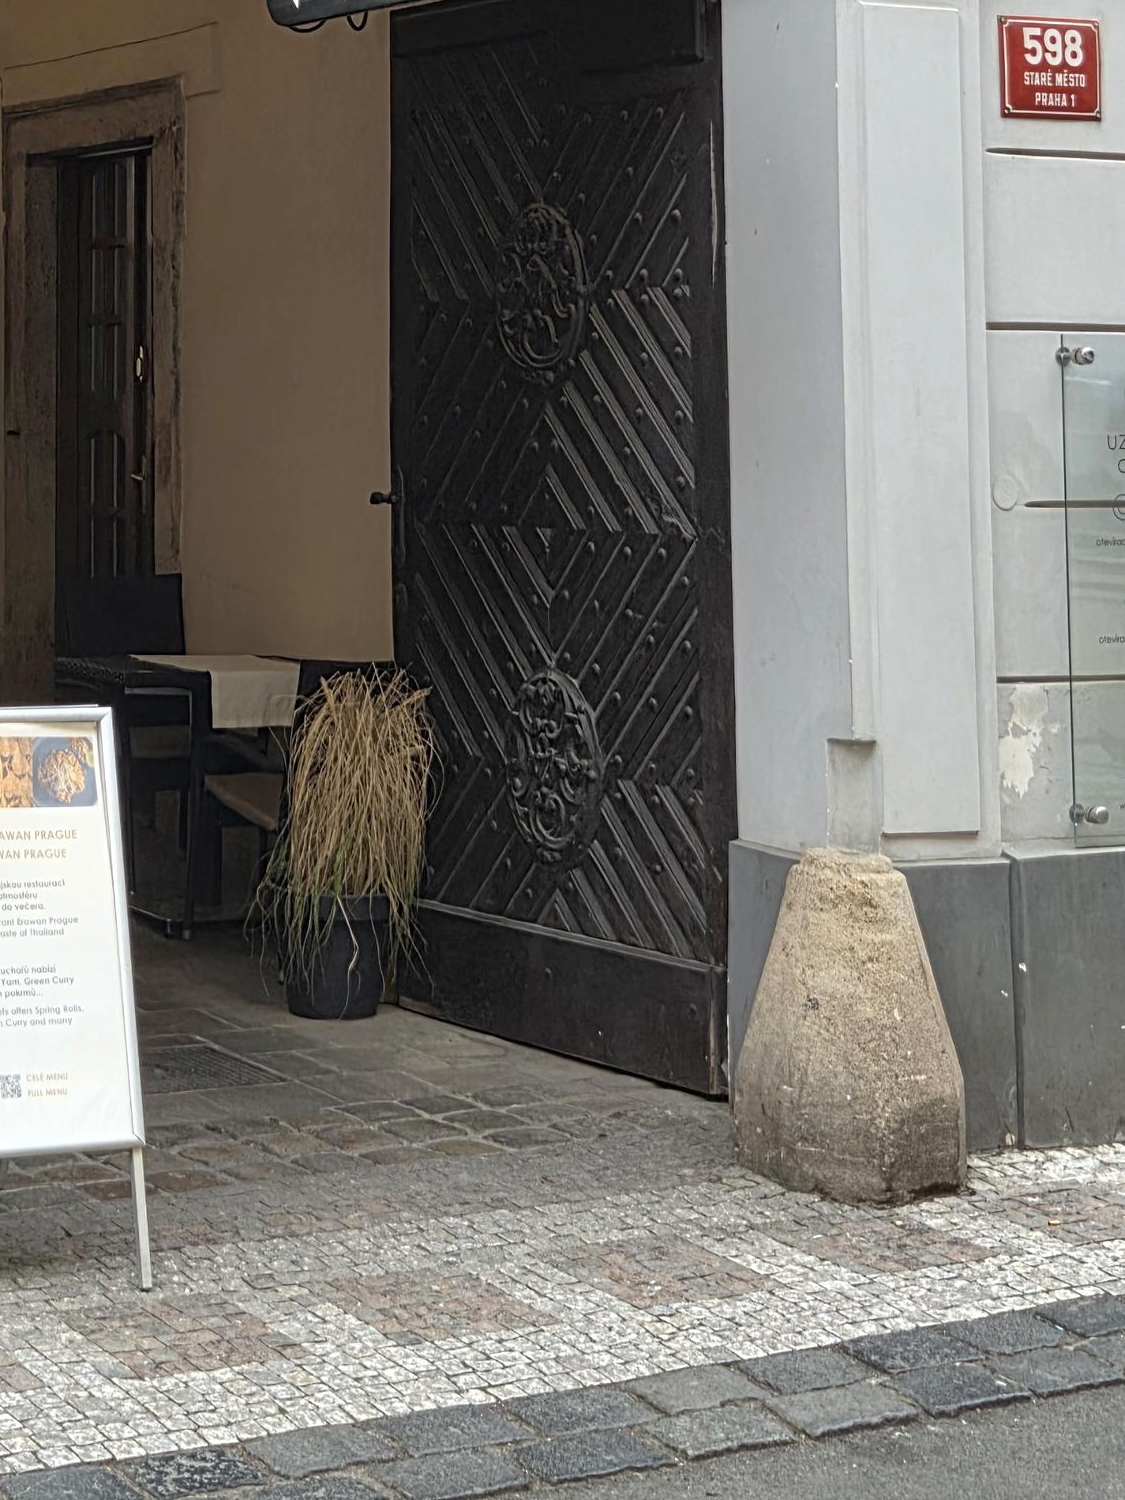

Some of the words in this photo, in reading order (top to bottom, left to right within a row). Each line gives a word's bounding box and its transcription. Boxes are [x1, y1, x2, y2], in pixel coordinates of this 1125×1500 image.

[1023, 27, 1084, 67] 598
[1024, 69, 1052, 86] STARÉ
[1055, 69, 1086, 87] MĚSTO
[1035, 92, 1067, 107] PRAHA
[1070, 94, 1075, 107] 1
[35, 829, 78, 840] PRAGUE
[24, 848, 67, 859] PRAGUE
[17, 917, 46, 926] Erawan
[49, 916, 78, 925] Prague
[20, 929, 27, 937] of
[30, 928, 64, 936] Thailand
[24, 977, 50, 985] Green
[52, 976, 74, 985] Curry
[12, 1007, 33, 1015] offers
[35, 1006, 60, 1016] Spring
[6, 1018, 27, 1027] Curry
[30, 1017, 46, 1026] and
[48, 1017, 72, 1026] many
[46, 1072, 68, 1081] MENU
[27, 1089, 44, 1098] FULL
[45, 1088, 67, 1097] MENU
